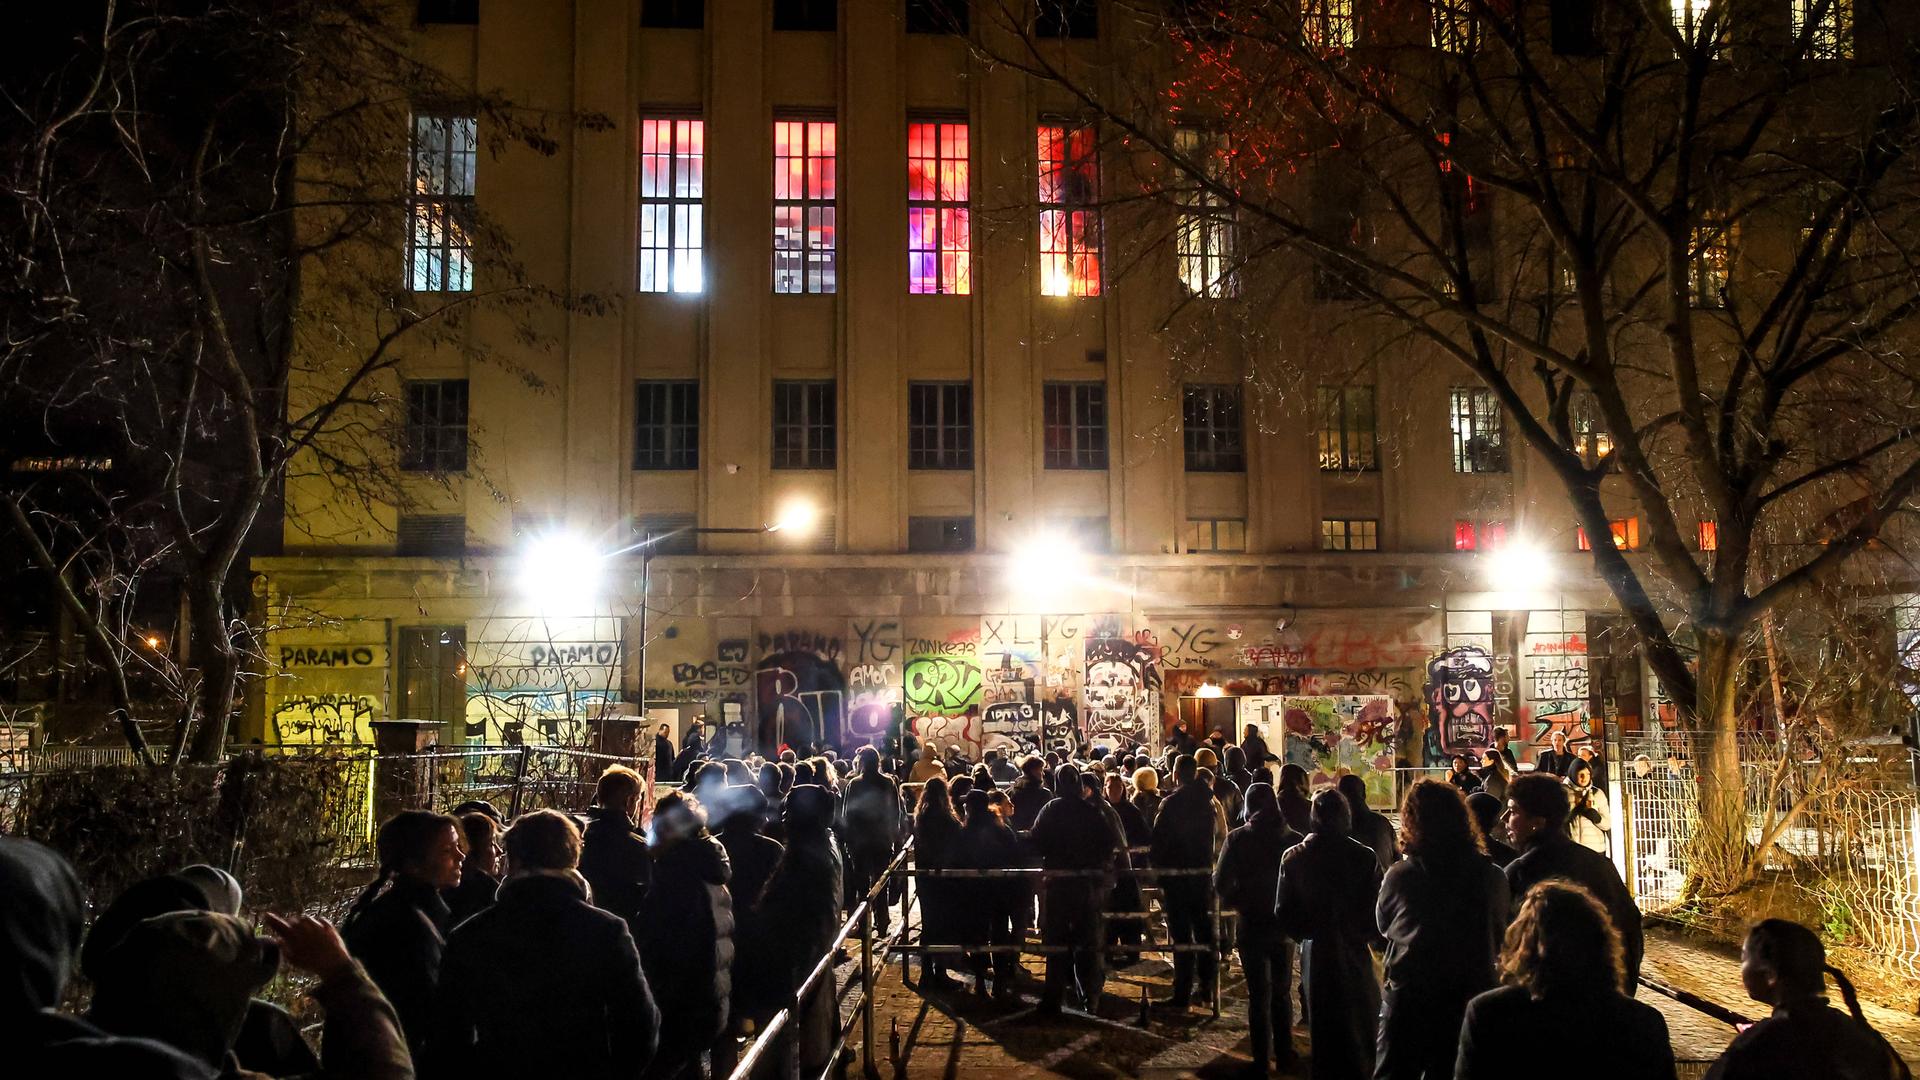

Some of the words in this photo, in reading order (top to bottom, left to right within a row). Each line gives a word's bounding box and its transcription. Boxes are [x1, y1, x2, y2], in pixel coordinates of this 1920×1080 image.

[852, 621, 900, 662] YG
[1172, 624, 1224, 654] YG
[280, 648, 373, 668] PARAMO
